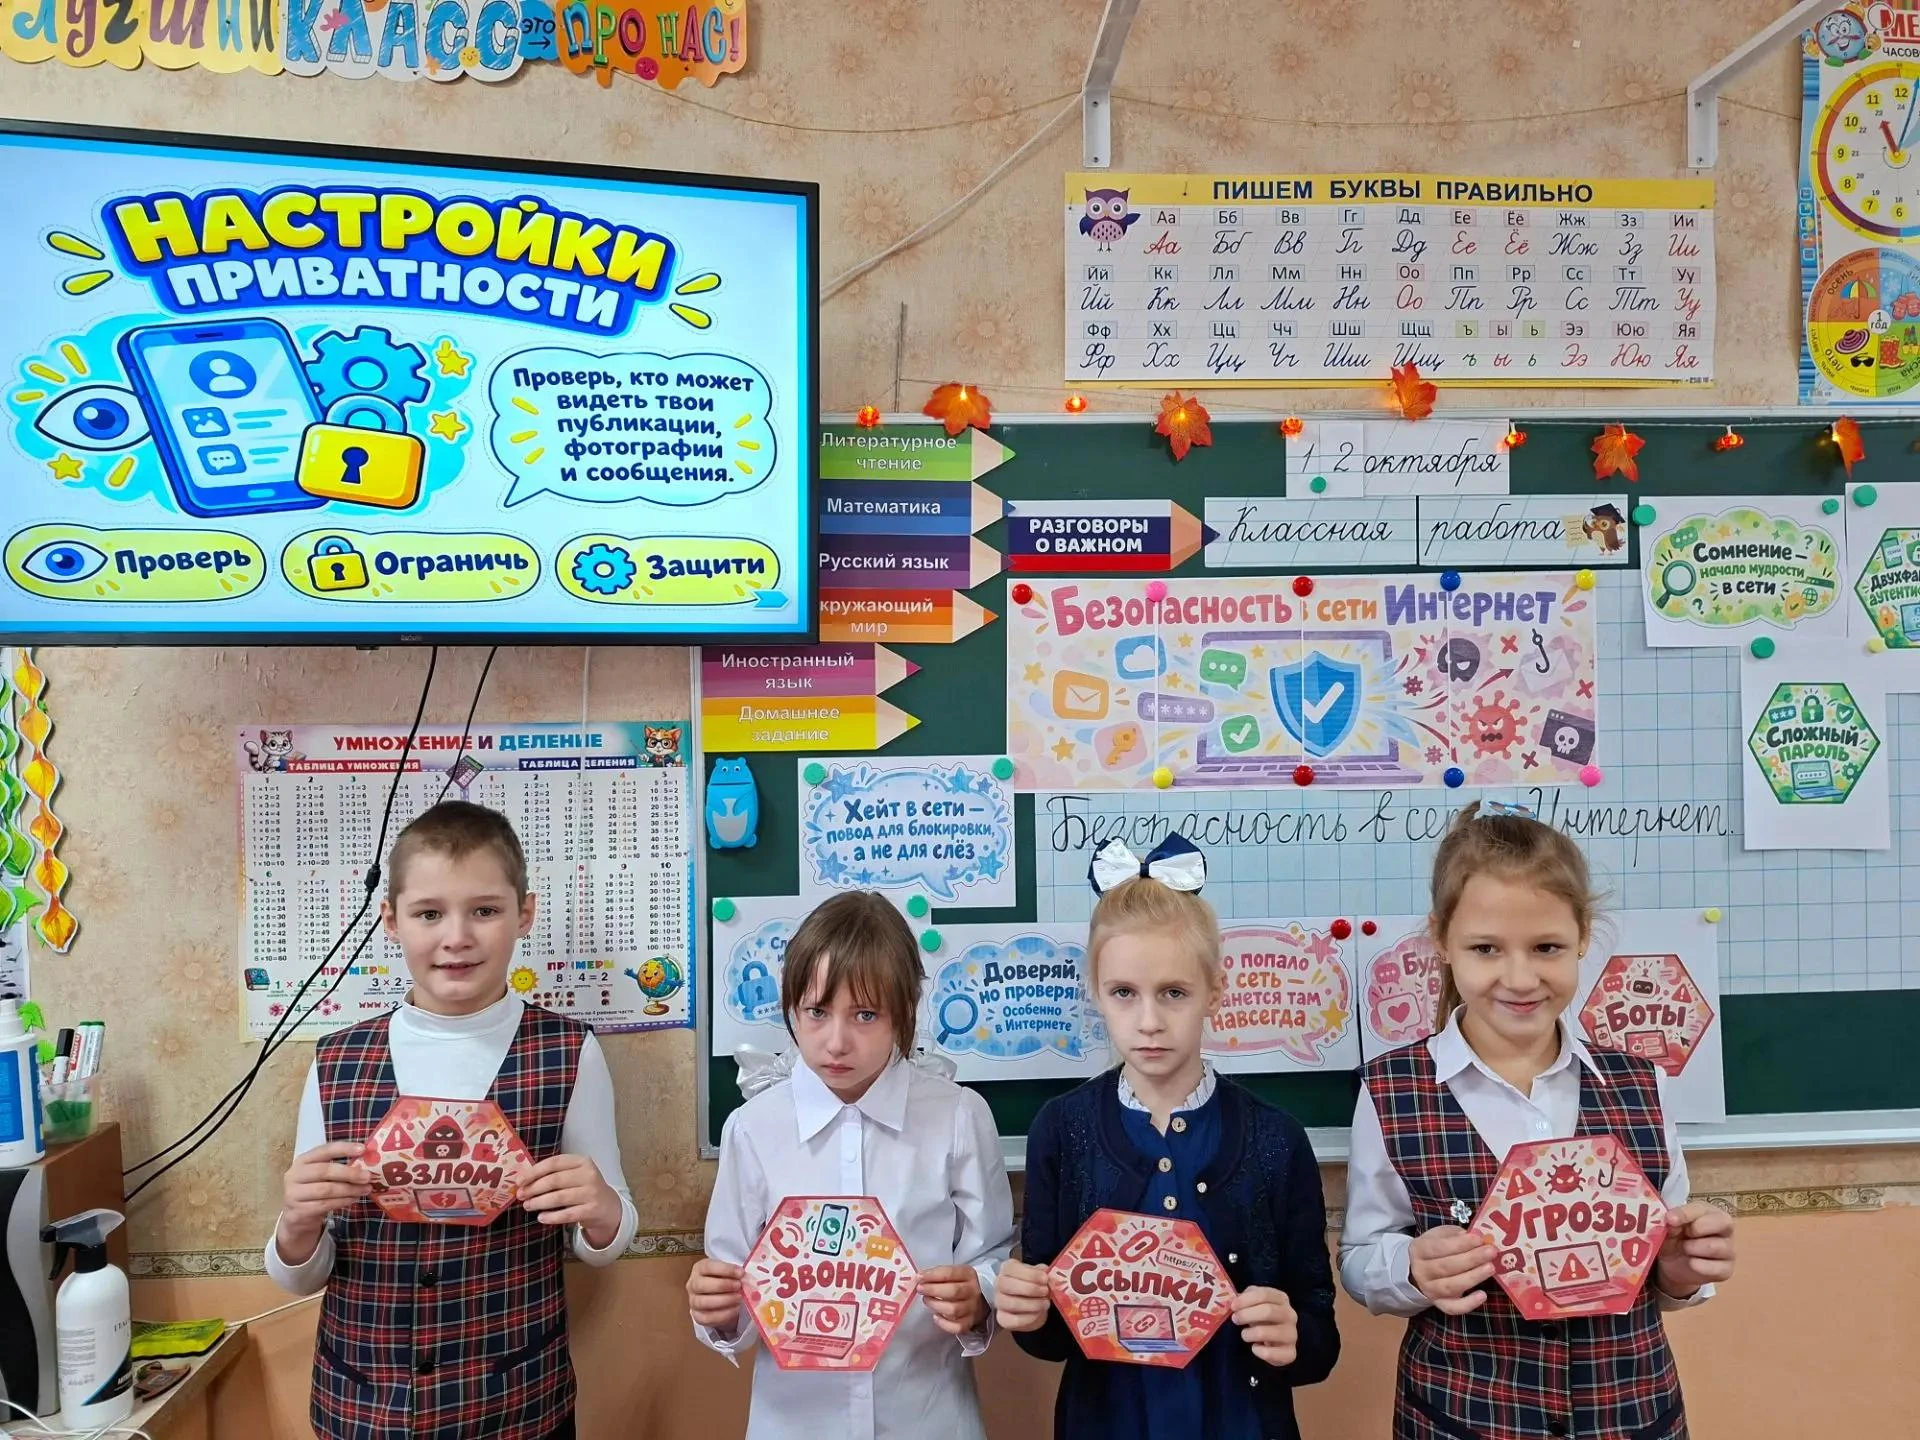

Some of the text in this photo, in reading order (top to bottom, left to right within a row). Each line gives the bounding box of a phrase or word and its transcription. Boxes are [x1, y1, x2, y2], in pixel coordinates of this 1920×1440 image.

[287, 0, 520, 70] КЛАСС
[522, 18, 555, 34] ЭТО
[564, 3, 740, 66] ПРО НАС!
[1883, 48, 1920, 57] ЧАСОВ
[1867, 95, 1879, 104] 11
[1895, 88, 1908, 97] 12
[1845, 117, 1858, 127] 10
[1838, 149, 1844, 158] 9
[1213, 180, 1593, 202] ПИШЕМ БУКВЫ ПРАВИЛЬНО
[1845, 179, 1851, 188] 8
[1867, 201, 1873, 210] 7
[1896, 208, 1902, 217] 6
[1157, 208, 1693, 227] Аа Бб Вв Гг Дд Ее Ёё Жж Зз Ии
[115, 192, 666, 290] НАСТРОЙКИ
[1088, 264, 1694, 283] Йй Кк Лл Мм Нн Оо Пп Рр Сс Тт Уу
[1828, 270, 1853, 295] осень
[168, 258, 619, 327] ПРИВАТНОСТИ
[1088, 325, 1111, 338] Фф
[1153, 323, 1170, 337] Хх
[1214, 323, 1236, 338] Цц
[1274, 322, 1292, 336] Чч
[1333, 321, 1360, 336] Шш
[1401, 321, 1431, 337] Щщ
[1566, 323, 1583, 336] Ээ
[1617, 323, 1644, 337] Юю
[1679, 323, 1695, 337] Яя
[1825, 349, 1843, 371] лето
[513, 368, 754, 391] Проверь, кто может
[557, 394, 714, 412] видеть твои
[558, 414, 722, 438] публикации,
[564, 438, 723, 461] фотографии
[820, 434, 957, 451] Литературное
[856, 456, 922, 470] чтение
[1363, 438, 1502, 487] октября
[560, 462, 734, 483] и сообщения.
[827, 498, 940, 514] Математика
[1029, 518, 1149, 534] РАЗГОВОРЫ
[1228, 503, 1566, 556] Классная работа
[1035, 538, 1142, 553] О ВАЖНОМ
[1693, 543, 1792, 563] Сомнение
[115, 548, 251, 578] Проверь
[374, 551, 529, 580] Ограничь
[647, 554, 765, 582] Защити
[820, 553, 949, 572] Русский язык
[1701, 564, 1805, 579] начало мудрости
[1722, 581, 1776, 595] в сети
[820, 598, 933, 615] кружающий
[1051, 585, 1292, 636] Безопасность
[1317, 598, 1376, 621] сети
[1384, 584, 1556, 627] Интернет
[851, 622, 888, 636] мир
[722, 652, 854, 668] Иностранный
[765, 677, 812, 689] язык
[739, 706, 840, 723] Домашнее
[333, 733, 603, 751] УМНОЖЕНИЕ И ДЕЛЕНИЕ
[752, 728, 828, 742] задание
[1766, 725, 1859, 748] Сложный
[289, 762, 344, 771] ТАБЛИЦА
[521, 758, 635, 769] ТАБЛИЦА ДЕЛЕНИЯ
[844, 798, 965, 824] Хейт в сети
[1046, 796, 1347, 851] Безопасность
[1359, 790, 1396, 842] в
[826, 819, 995, 844] повод для блокировки,
[853, 839, 975, 861] а не для слёз
[1241, 953, 1309, 971] попало
[983, 959, 1080, 986] Доверяй,
[1236, 971, 1281, 988] сеть
[979, 988, 1000, 1004] но
[1222, 991, 1321, 1008] анется там
[1003, 1003, 1062, 1017] Особенно
[1605, 1001, 1686, 1032] Боты
[995, 1019, 1072, 1033] в Интернете
[381, 1161, 503, 1188] Взлом
[1488, 1200, 1649, 1247] Угрозы
[1163, 1253, 1197, 1269] https://
[772, 1260, 896, 1299] Звонки
[1070, 1261, 1214, 1309] Ссылки
